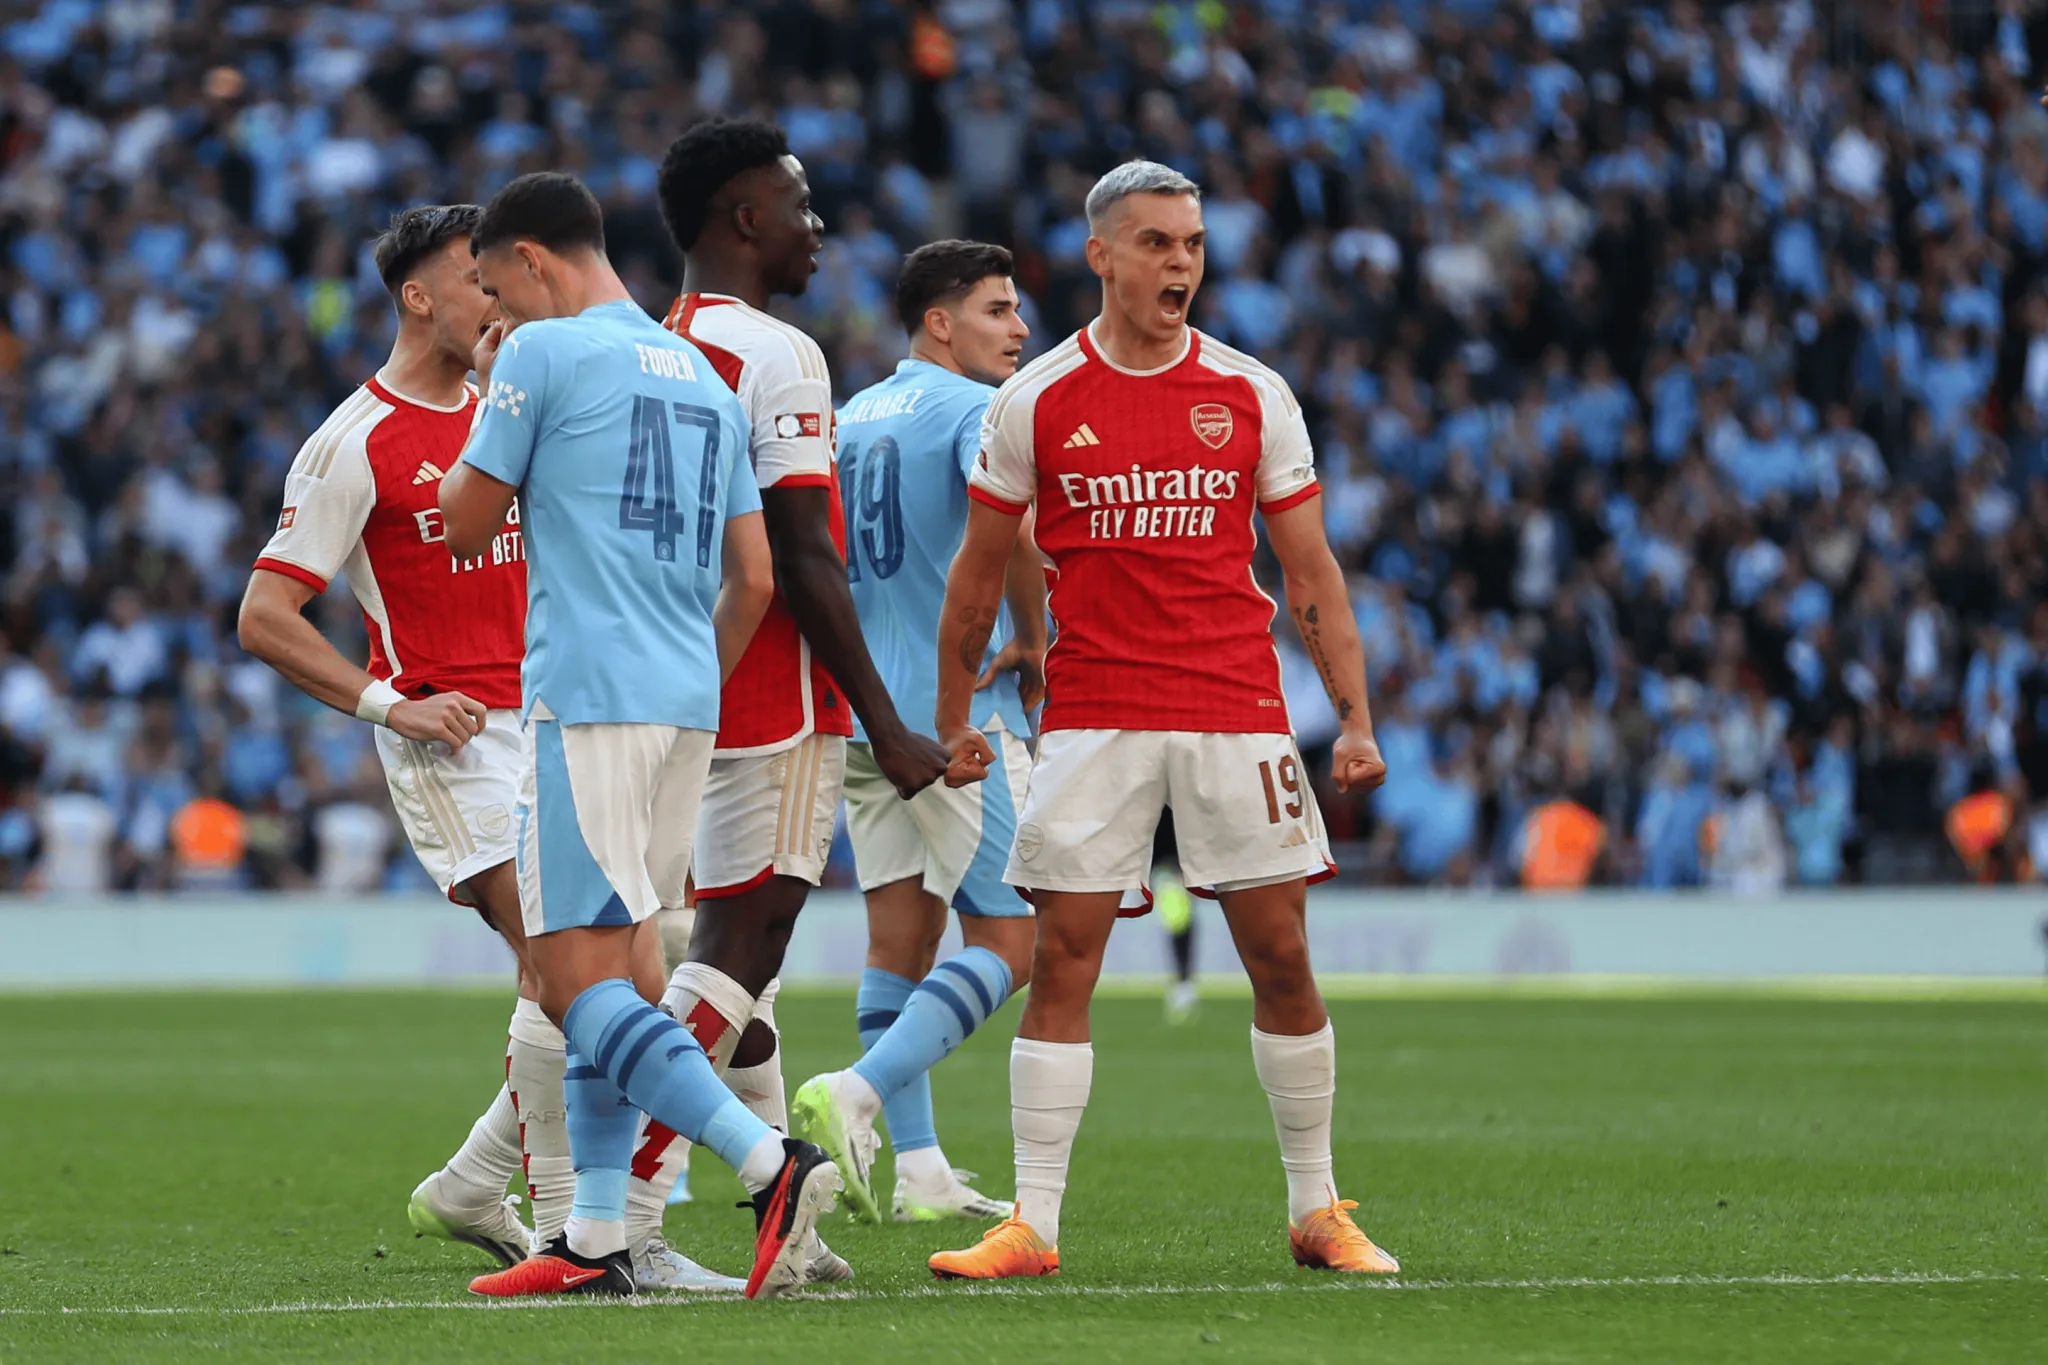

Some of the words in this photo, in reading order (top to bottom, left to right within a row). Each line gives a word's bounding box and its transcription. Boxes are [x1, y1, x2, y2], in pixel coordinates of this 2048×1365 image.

[635, 342, 697, 382] FODEN
[619, 395, 721, 569] 47
[836, 434, 906, 583] 19
[1058, 463, 1240, 508] Emirates
[1089, 506, 1125, 539] FLY
[1132, 505, 1216, 538] BETTER
[1258, 754, 1303, 824] 19
